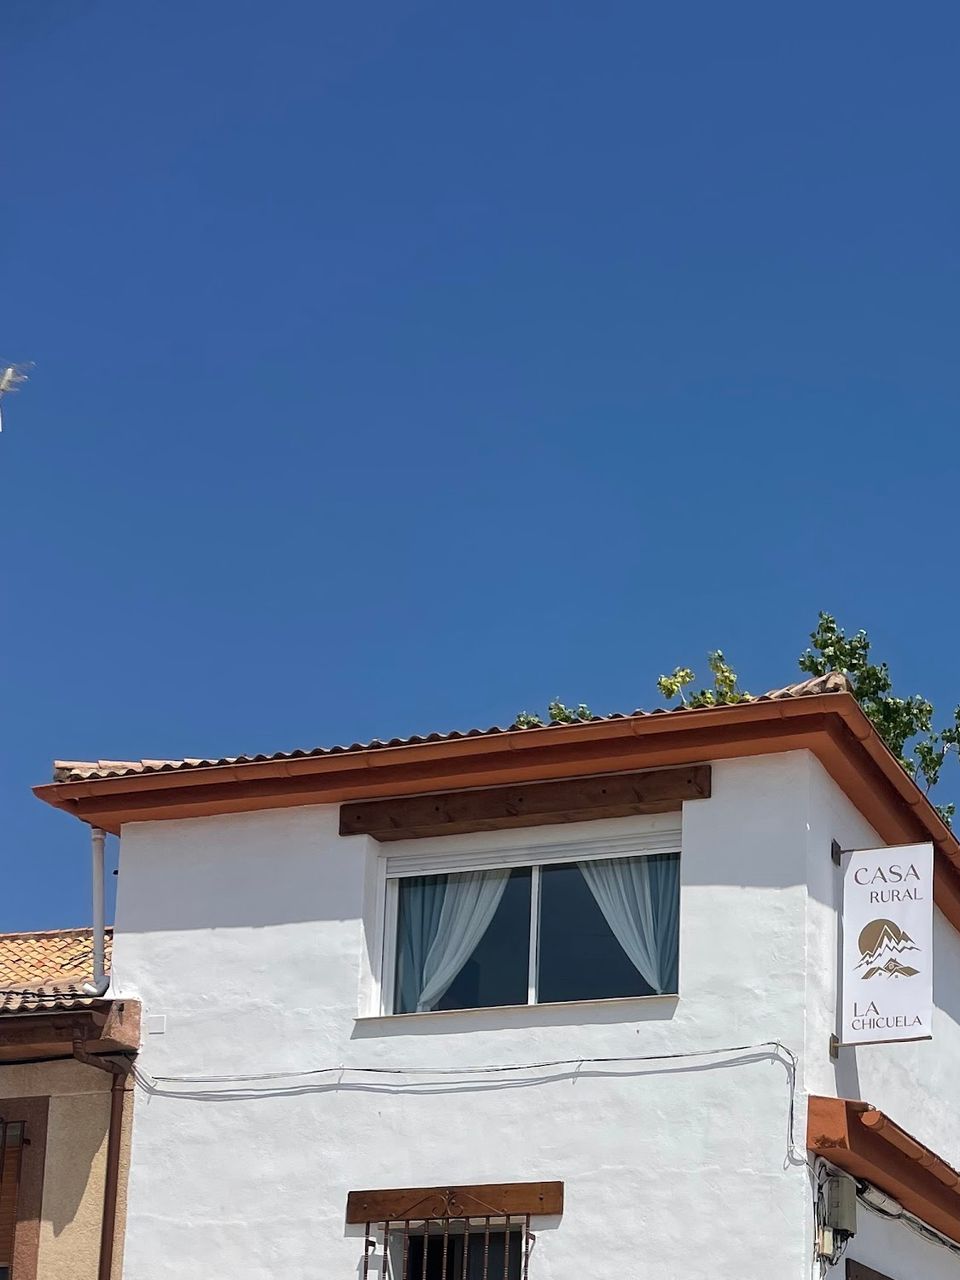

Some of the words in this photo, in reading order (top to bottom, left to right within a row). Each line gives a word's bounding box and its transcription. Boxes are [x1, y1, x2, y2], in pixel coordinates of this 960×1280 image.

[854, 863, 921, 886] CASA
[870, 888, 924, 904] RURAL
[853, 1001, 880, 1018] LA
[851, 1015, 923, 1031] CHICUELA
